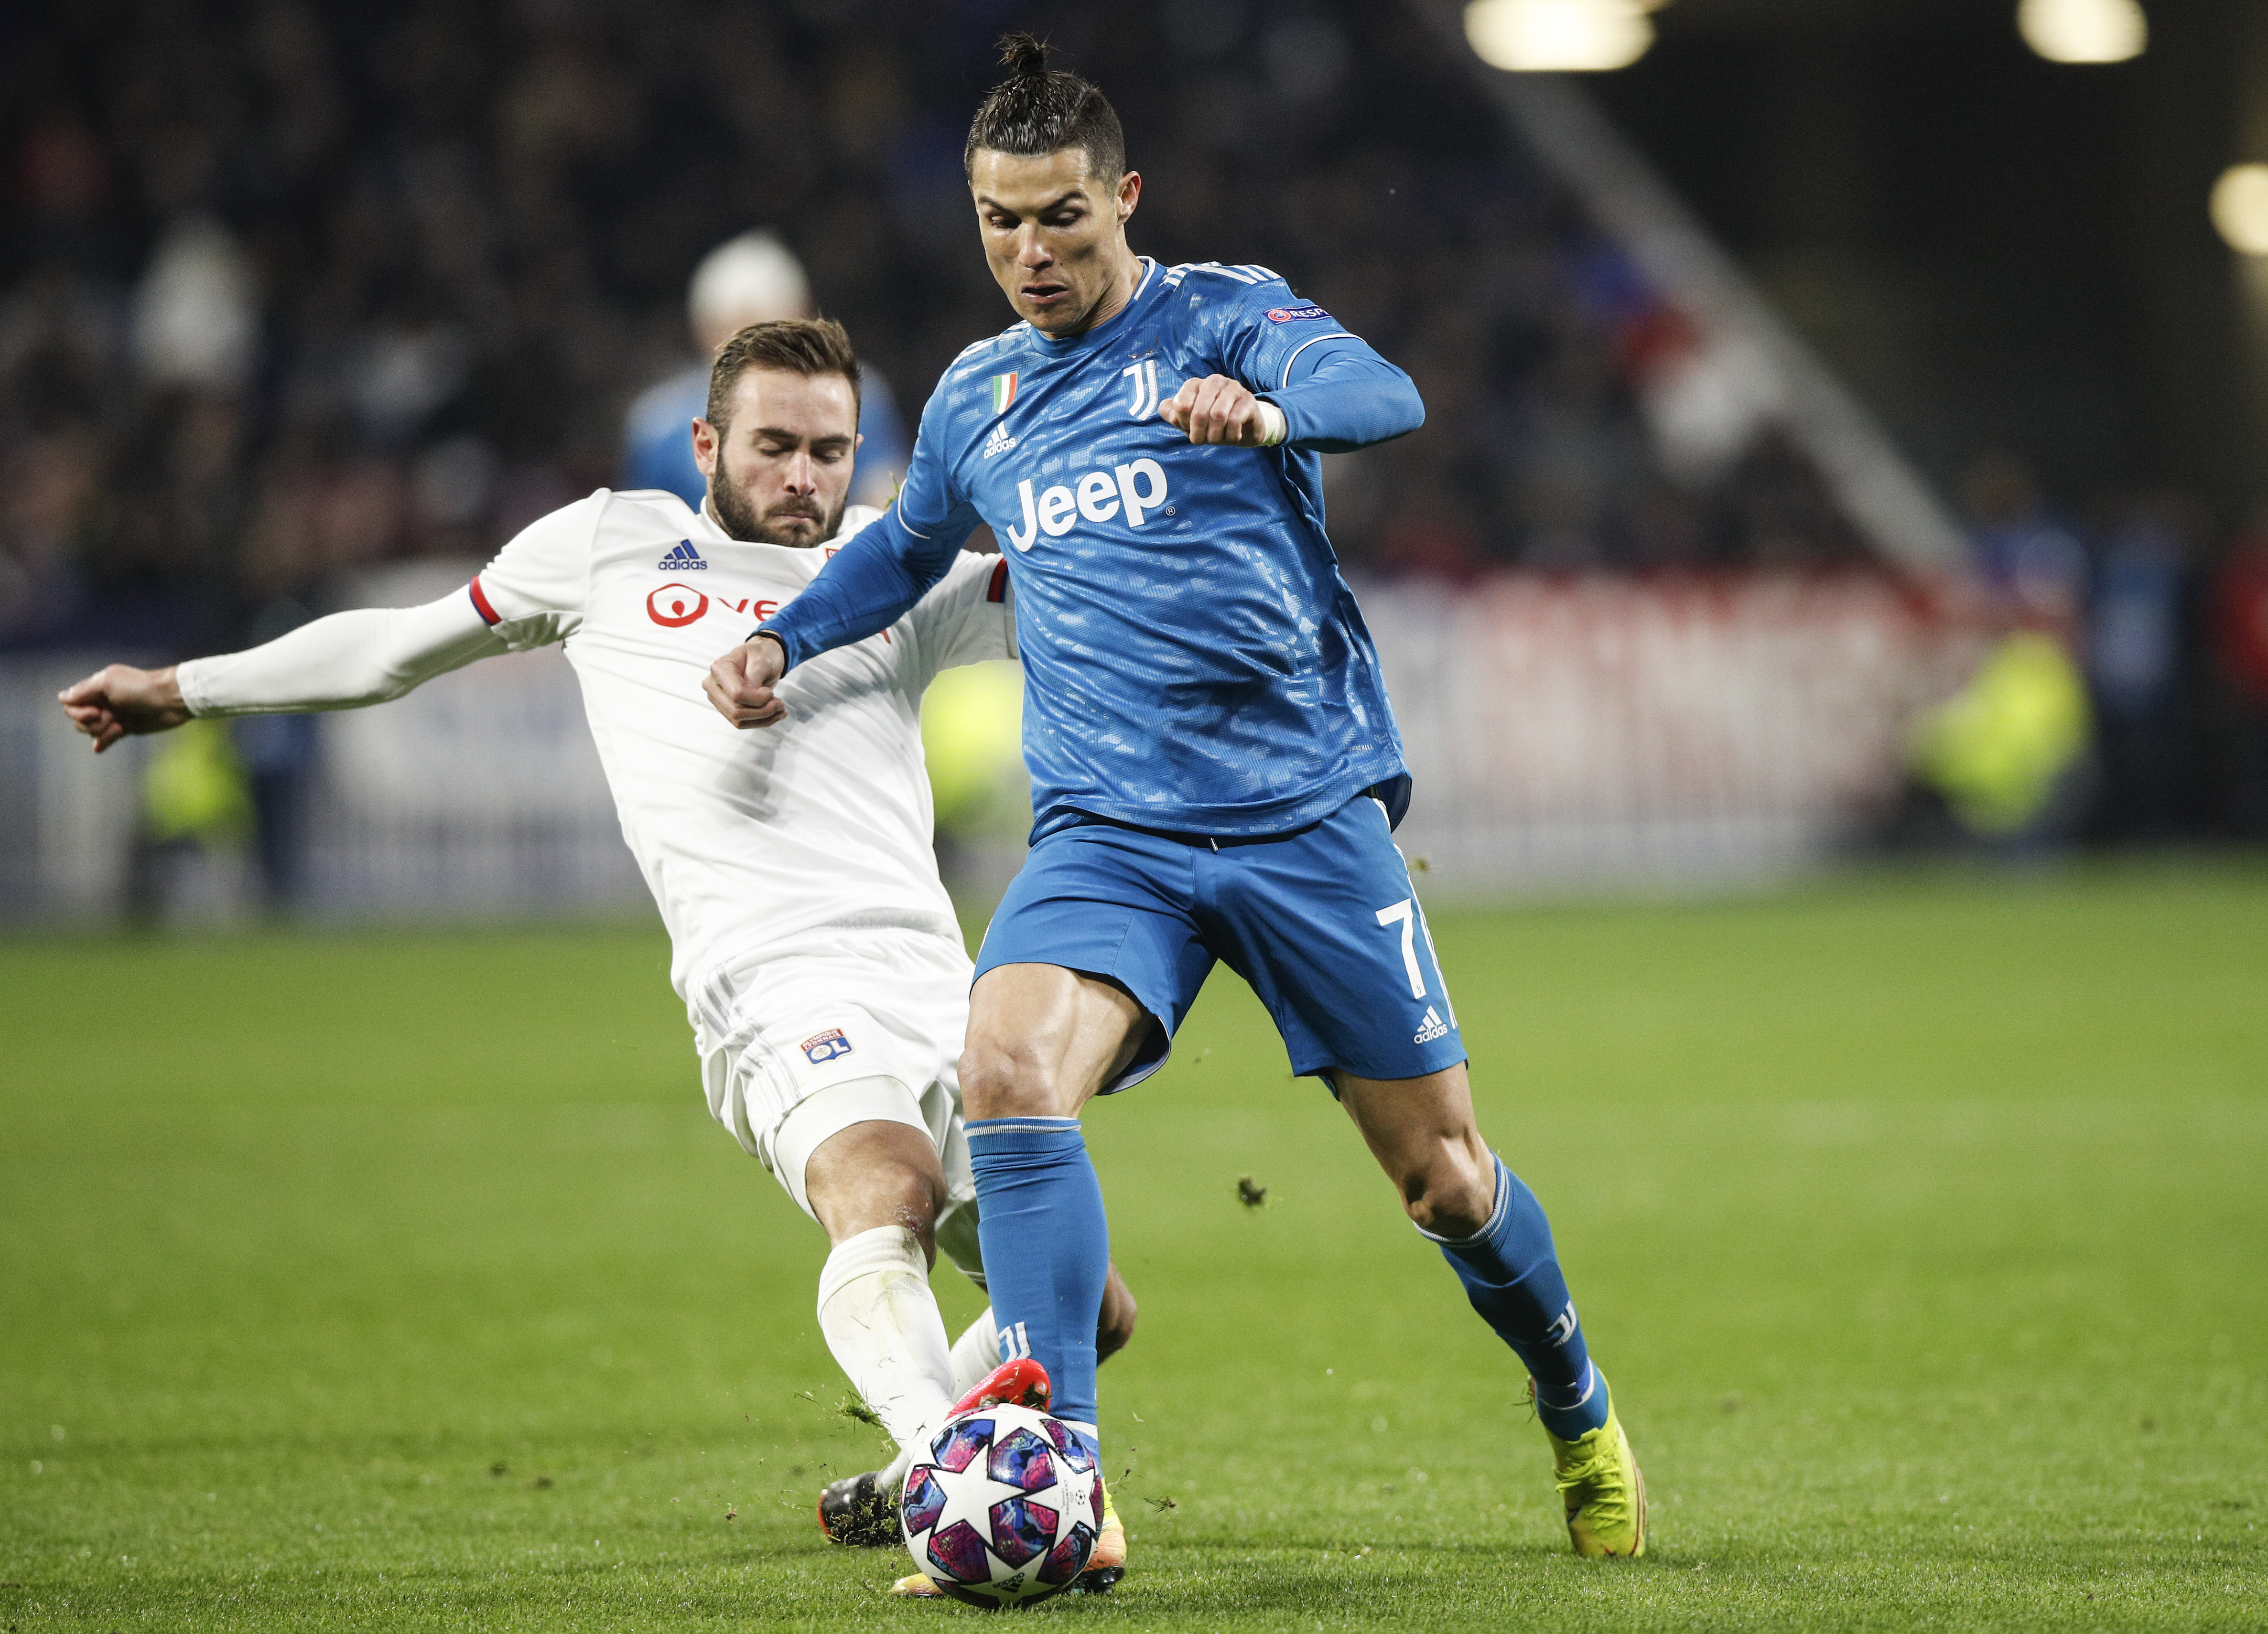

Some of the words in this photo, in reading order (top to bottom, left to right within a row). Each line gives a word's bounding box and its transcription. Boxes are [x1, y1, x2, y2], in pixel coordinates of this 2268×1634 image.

[983, 437, 1016, 459] adidas
[1006, 458, 1168, 552] Jeep
[659, 559, 707, 570] adidas
[1375, 898, 1426, 1000] 7
[803, 1029, 838, 1047] OLYMPIQUE
[804, 1032, 841, 1050] LYONNAIS
[1414, 1023, 1448, 1044] adidas
[993, 1572, 1025, 1588] adidas
